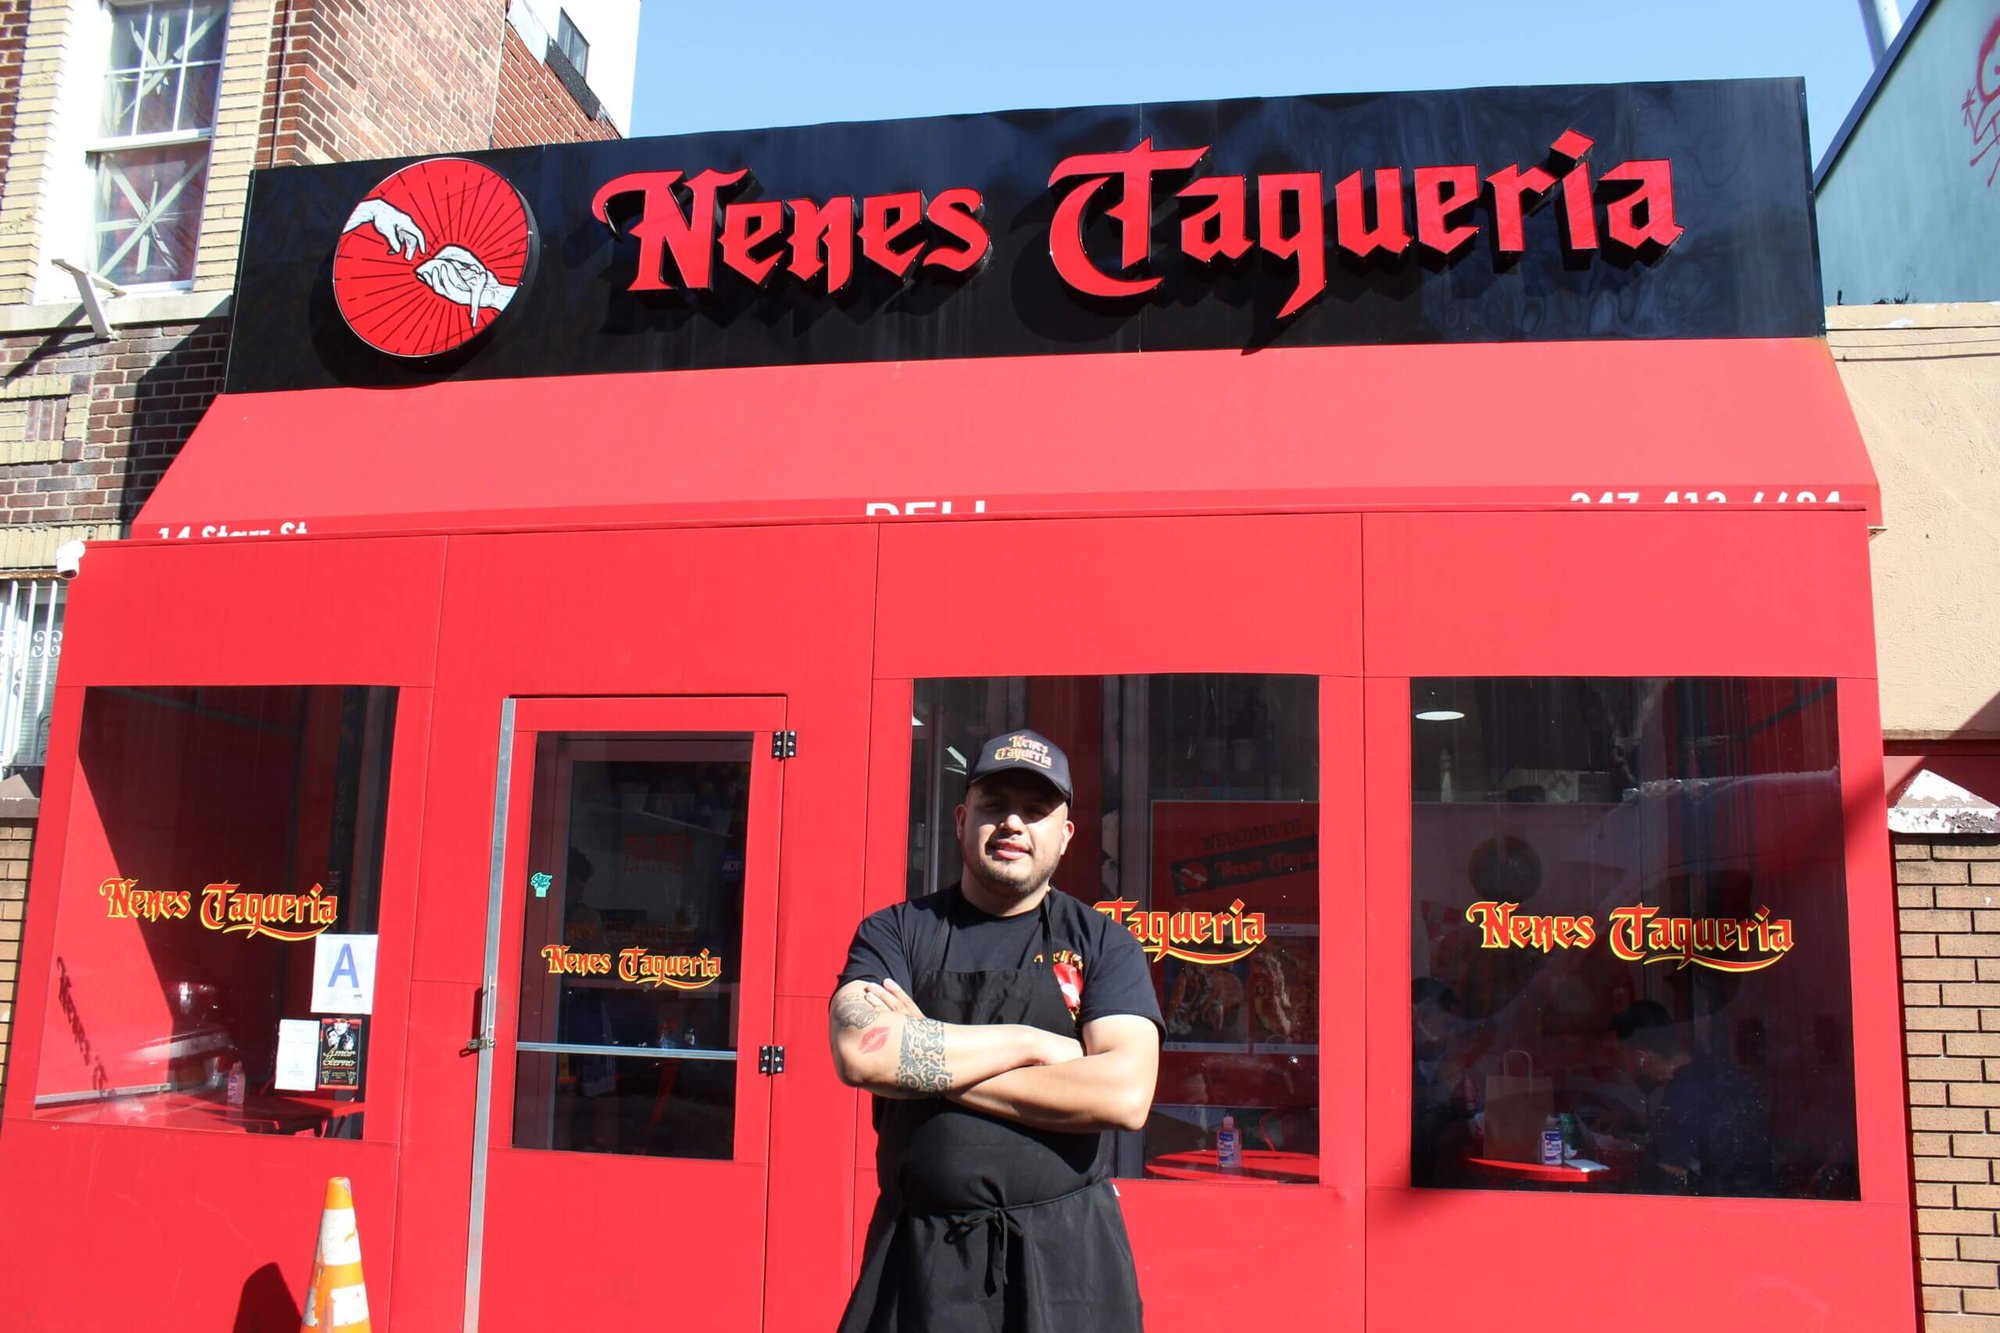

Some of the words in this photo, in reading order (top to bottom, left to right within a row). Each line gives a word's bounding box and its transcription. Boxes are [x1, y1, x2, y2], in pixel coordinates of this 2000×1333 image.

[592, 167, 992, 295] Nenes
[1048, 128, 1687, 320] Taqueria
[1009, 735, 1049, 754] Nenes
[99, 878, 191, 923] Nenes
[200, 880, 338, 942] Taqueria
[1466, 901, 1596, 953] Nenes
[1609, 902, 1795, 972] Taqueria
[327, 943, 360, 988] A
[541, 944, 612, 976] Nenes
[618, 945, 722, 990] Taqueria
